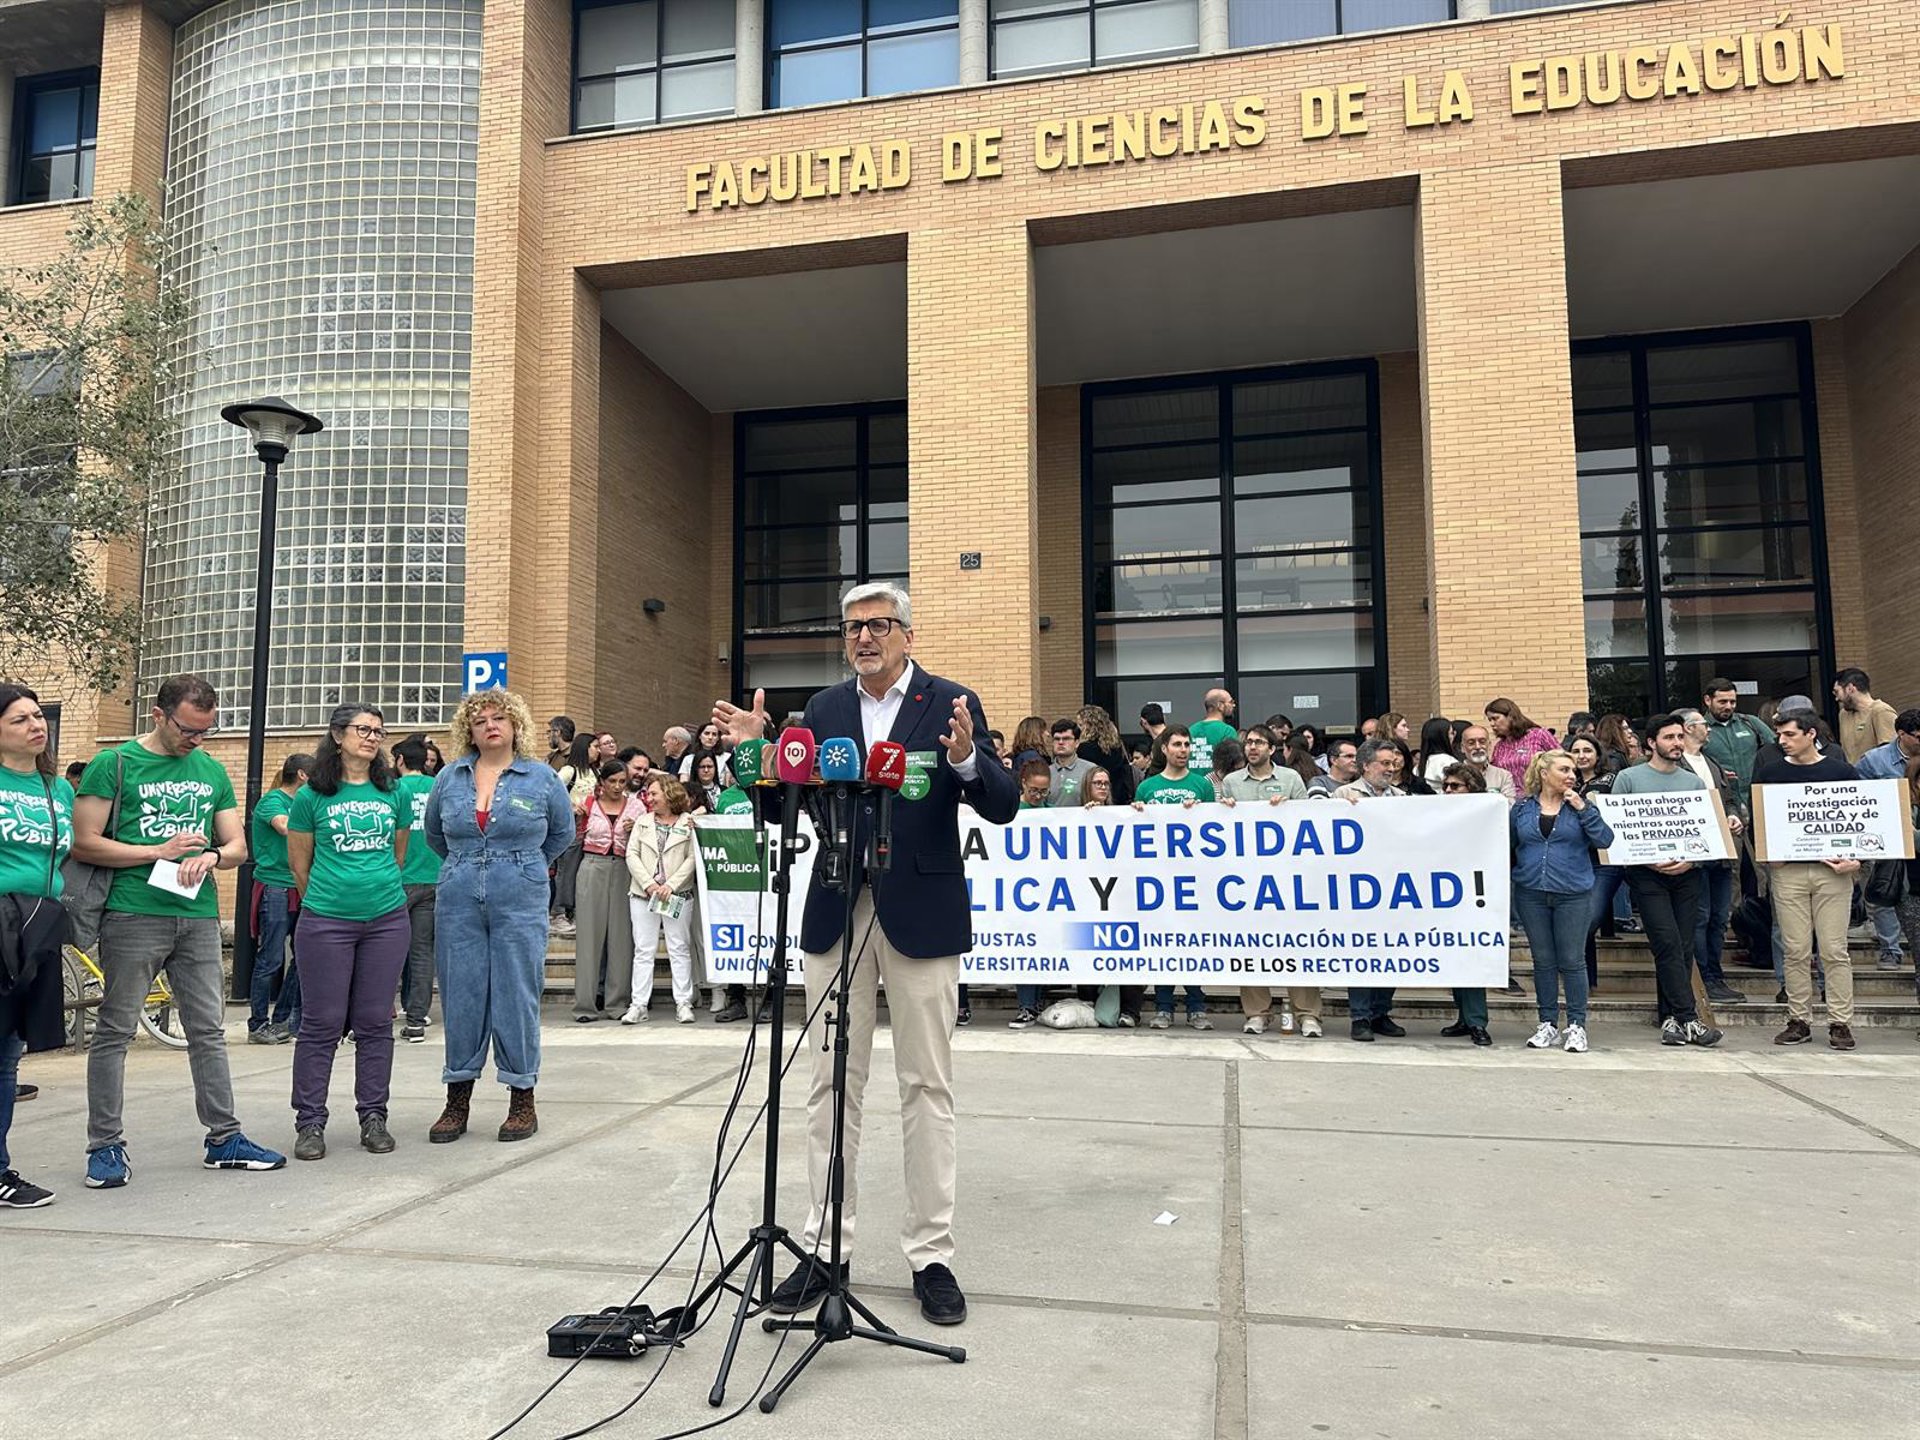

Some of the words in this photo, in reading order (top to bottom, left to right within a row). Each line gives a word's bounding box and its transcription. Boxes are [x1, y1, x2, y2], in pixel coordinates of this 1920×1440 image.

[686, 139, 911, 211] FACULTAD
[942, 127, 1003, 182] DE
[1034, 96, 1267, 171] CIENCIAS
[1301, 82, 1368, 140] DE
[1404, 69, 1474, 127] LA
[1509, 12, 1845, 115] EDUCACIÓN
[962, 553, 979, 567] 25
[468, 659, 492, 696] P
[787, 748, 804, 758] 101
[138, 780, 213, 798] UNIVERSIDAD
[1804, 785, 1827, 795] Por
[1831, 786, 1857, 794] una
[1605, 798, 1619, 807] La
[1621, 797, 1652, 807] Junta
[1655, 795, 1691, 806] ahoga
[1694, 795, 1702, 803] a
[1787, 796, 1877, 810] investigación
[327, 800, 393, 817] UNIVERSIDAD
[1625, 808, 1636, 817] la
[1638, 805, 1688, 817] PÚBLICA
[1788, 808, 1846, 822] PÚBLICA
[1849, 812, 1858, 822] y
[1862, 808, 1879, 818] de
[1613, 820, 1663, 829] mientras
[1665, 818, 1695, 829] aupa
[1698, 817, 1706, 825] a
[1803, 822, 1865, 834] CALIDAD
[960, 828, 990, 860] A
[1004, 818, 1364, 861] UNIVERSIDAD
[1623, 831, 1640, 840] las
[1642, 827, 1701, 840] PRIVADAS
[717, 861, 760, 873] PÚBLICA
[966, 876, 1076, 912] LICA
[1088, 877, 1119, 911] Y
[1136, 876, 1199, 911] DE
[1216, 871, 1486, 911] CALIDAD!
[716, 926, 740, 949] SI
[1092, 924, 1135, 948] NO
[1143, 928, 1345, 948] INFRAFINANCIACIÓN
[1352, 933, 1378, 948] DE
[1384, 932, 1410, 947] LA
[1415, 927, 1505, 947] PÚBLICA
[963, 957, 1070, 971] VERSITARIA
[1092, 957, 1225, 972] COMPLICIDAD
[1230, 958, 1255, 972] DE
[1261, 958, 1297, 972] LOS
[1302, 958, 1441, 973] RECTORADOS
